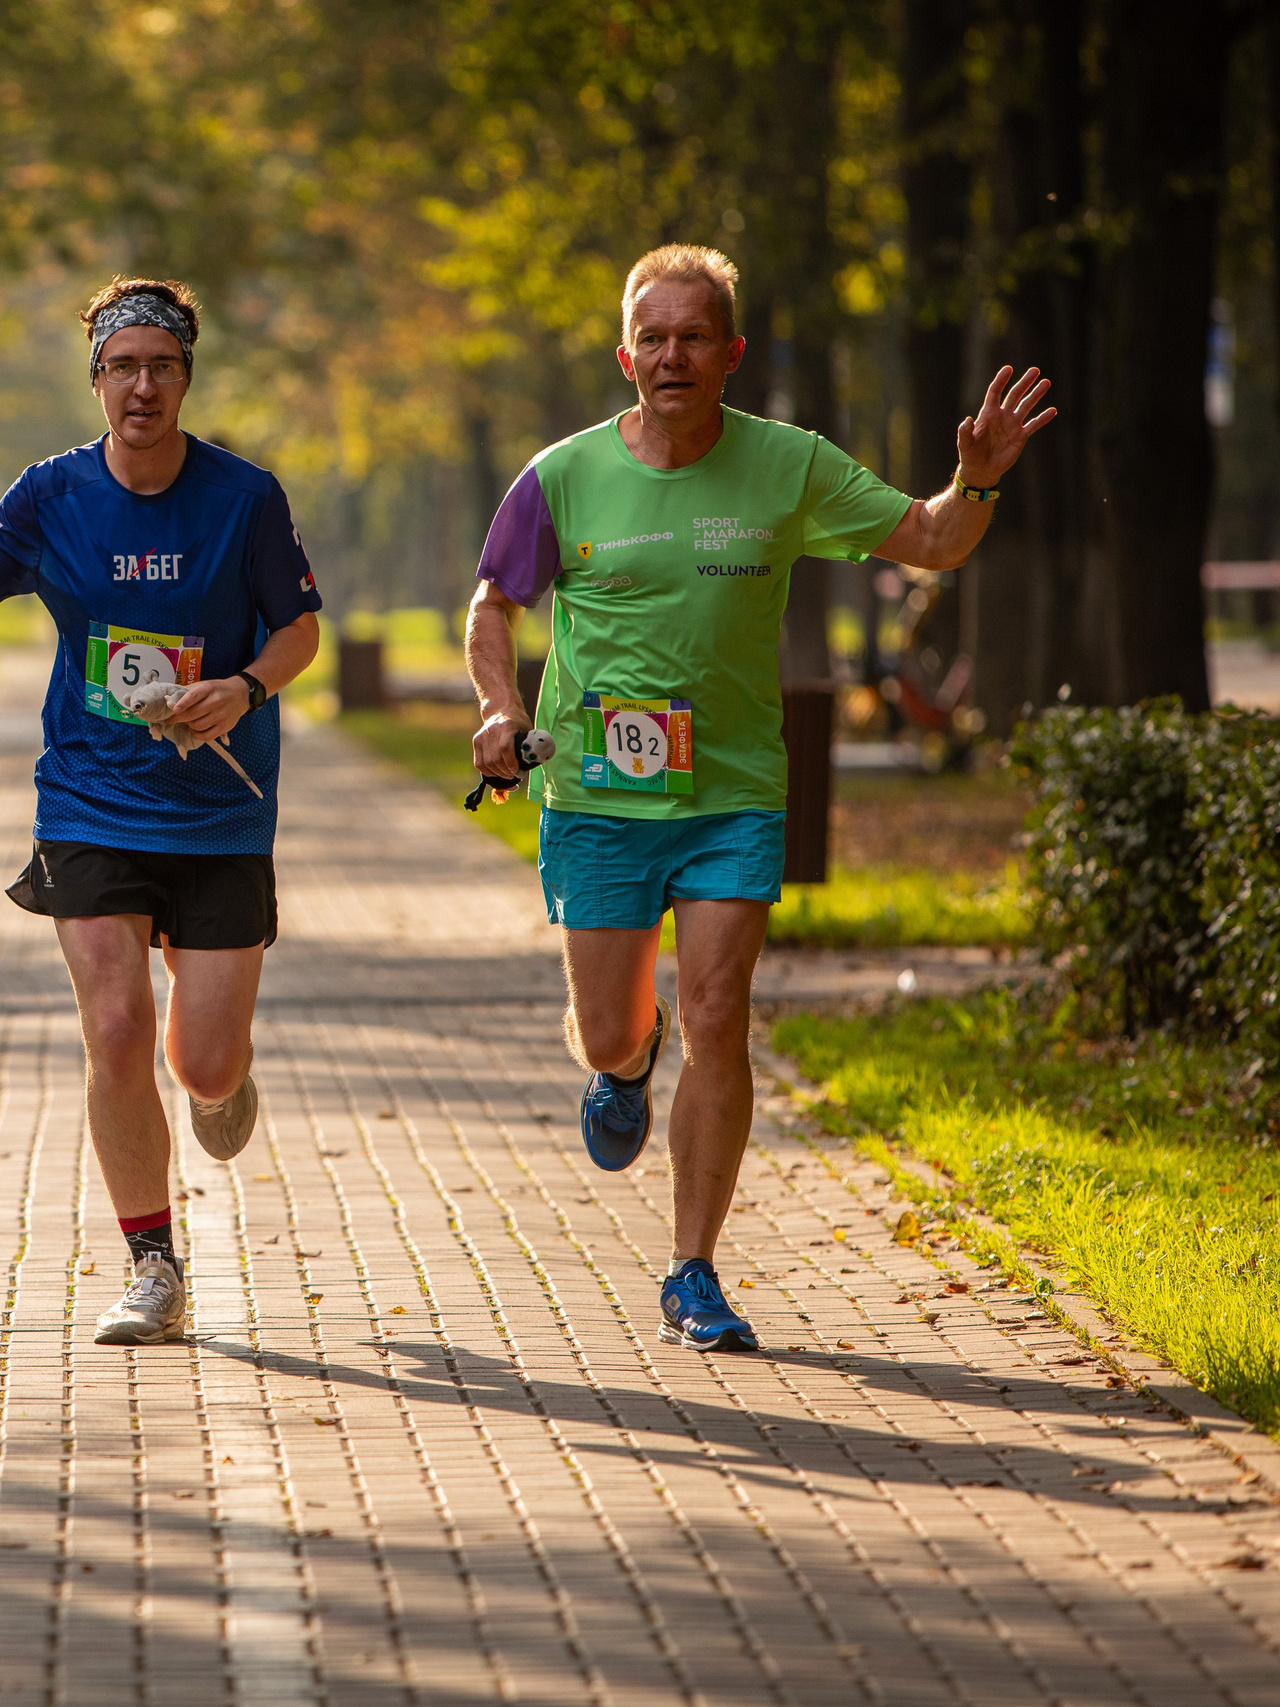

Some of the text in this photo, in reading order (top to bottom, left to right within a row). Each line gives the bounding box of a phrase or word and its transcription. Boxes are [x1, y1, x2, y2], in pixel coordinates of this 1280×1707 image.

[692, 517, 740, 529] SPORT
[595, 531, 674, 552] ТИНЬКОФФ
[703, 528, 774, 540] MARAFON
[694, 539, 729, 550] FEST
[696, 565, 771, 577] VOLUNTEER
[110, 634, 176, 660] DREAM TRAIL LYSKOVO
[122, 653, 141, 686] 5
[188, 658, 197, 685] АФЕТА
[638, 704, 665, 724] LYSKOVO
[612, 722, 660, 756] 18 2
[678, 721, 687, 764] ЭСТАФЕТА
[611, 768, 637, 786] KANNAS
